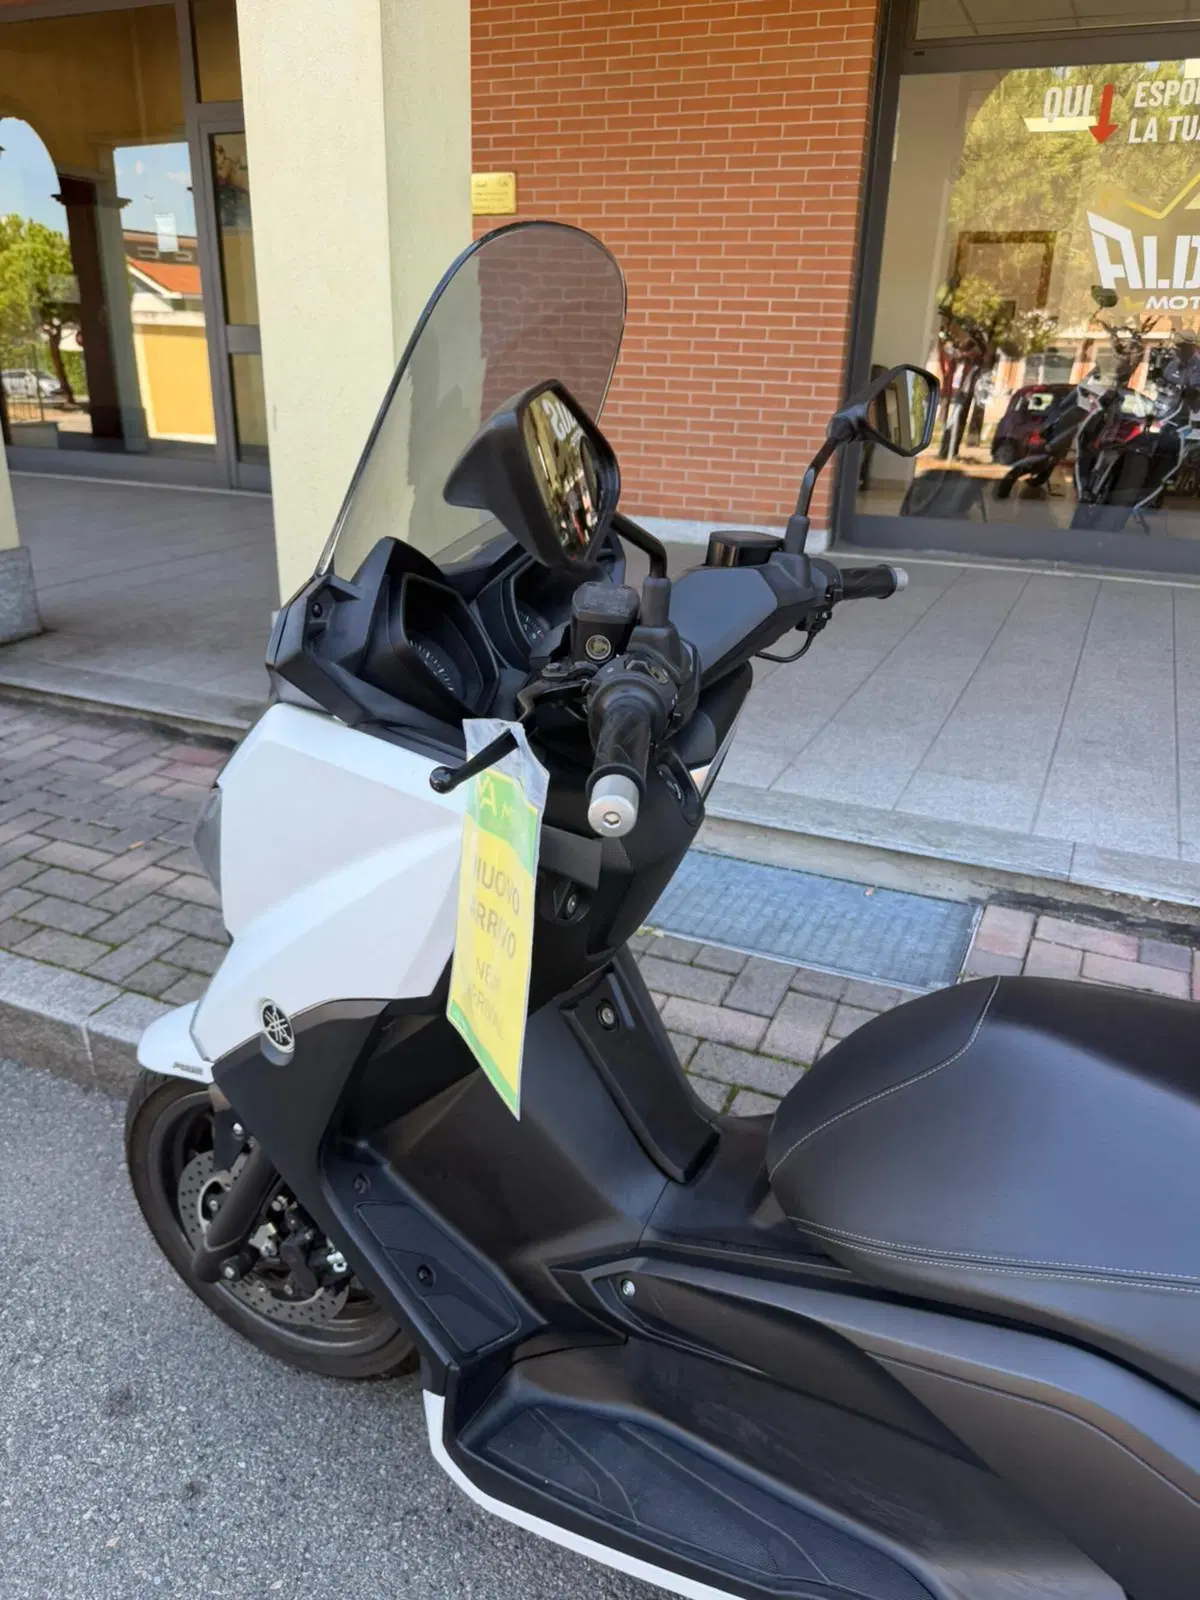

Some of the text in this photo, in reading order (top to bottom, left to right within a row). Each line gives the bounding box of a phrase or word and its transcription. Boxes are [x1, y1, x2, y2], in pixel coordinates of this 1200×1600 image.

[1043, 84, 1093, 122] QUI
[1129, 115, 1200, 143] LA TU
